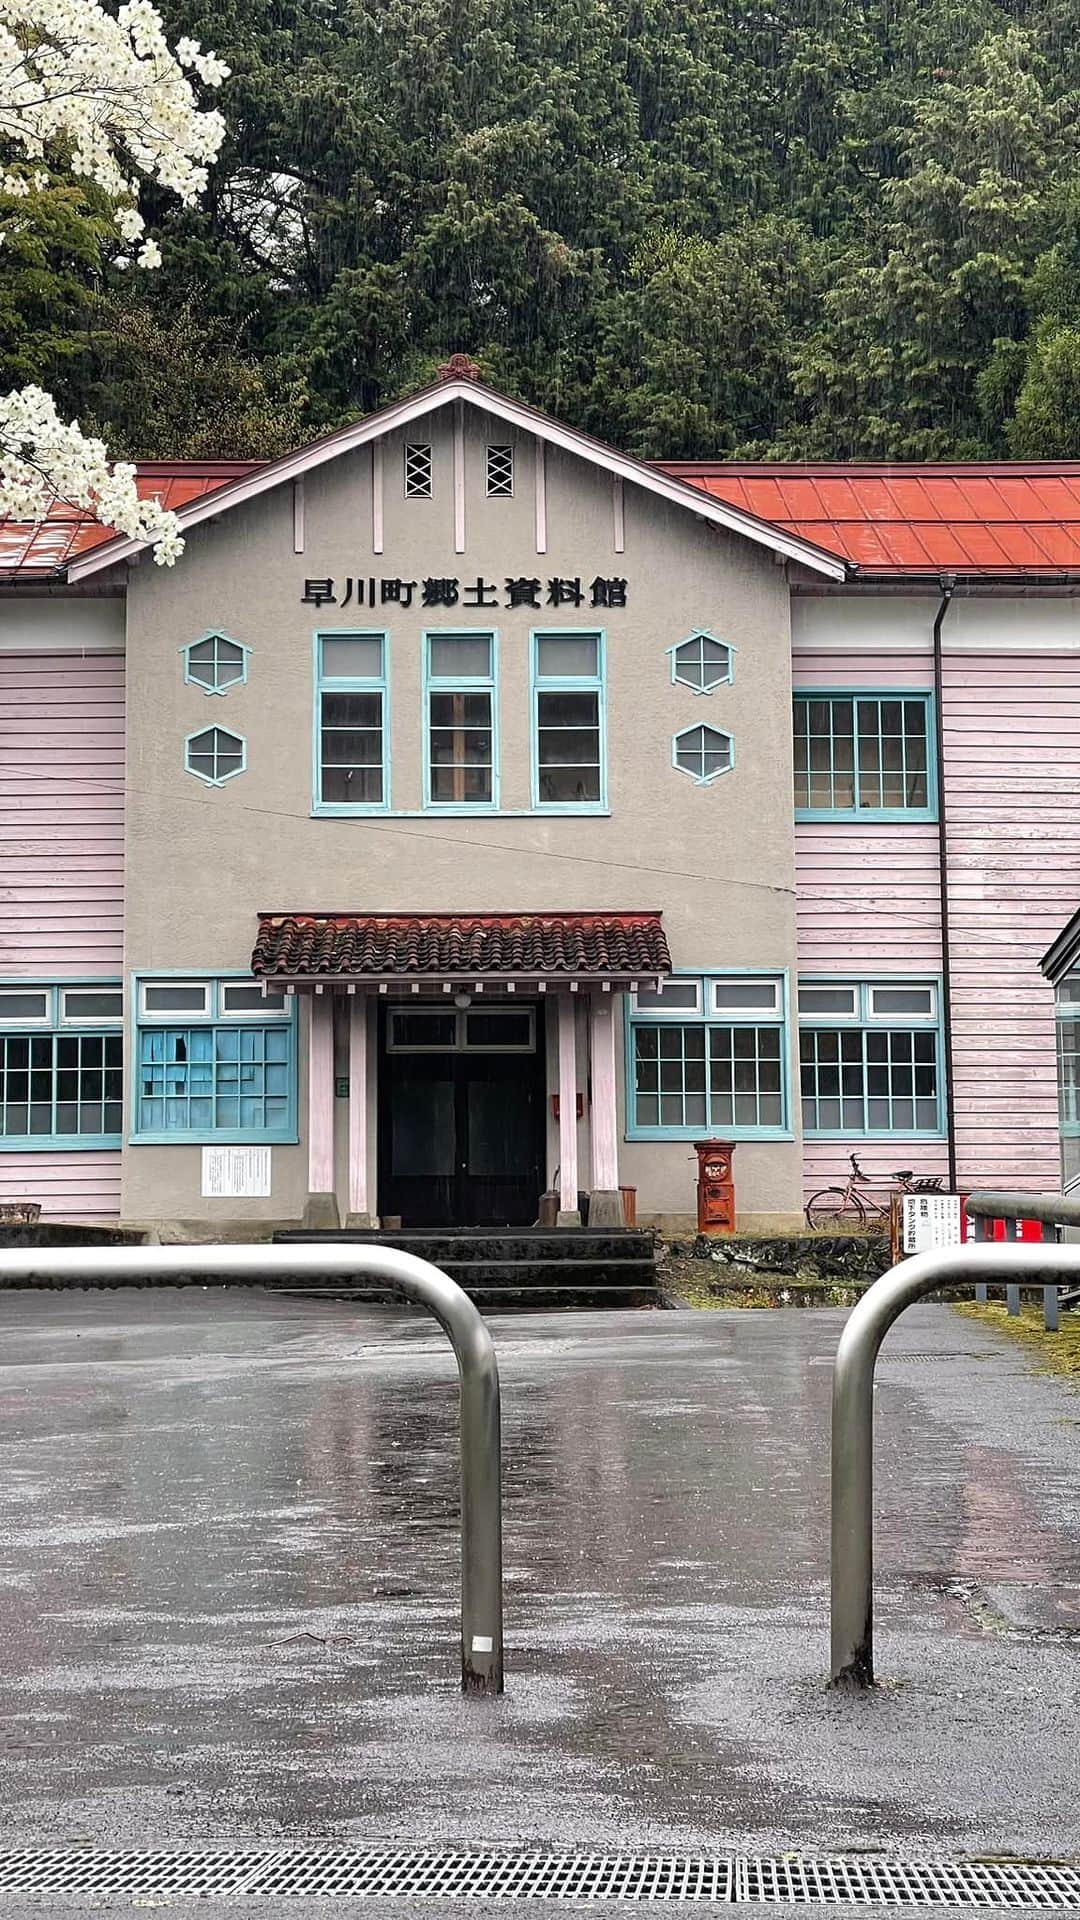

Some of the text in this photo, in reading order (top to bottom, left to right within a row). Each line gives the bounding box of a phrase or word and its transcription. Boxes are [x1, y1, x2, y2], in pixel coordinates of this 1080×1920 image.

[301, 577, 628, 609] 早川町郷土資料館
